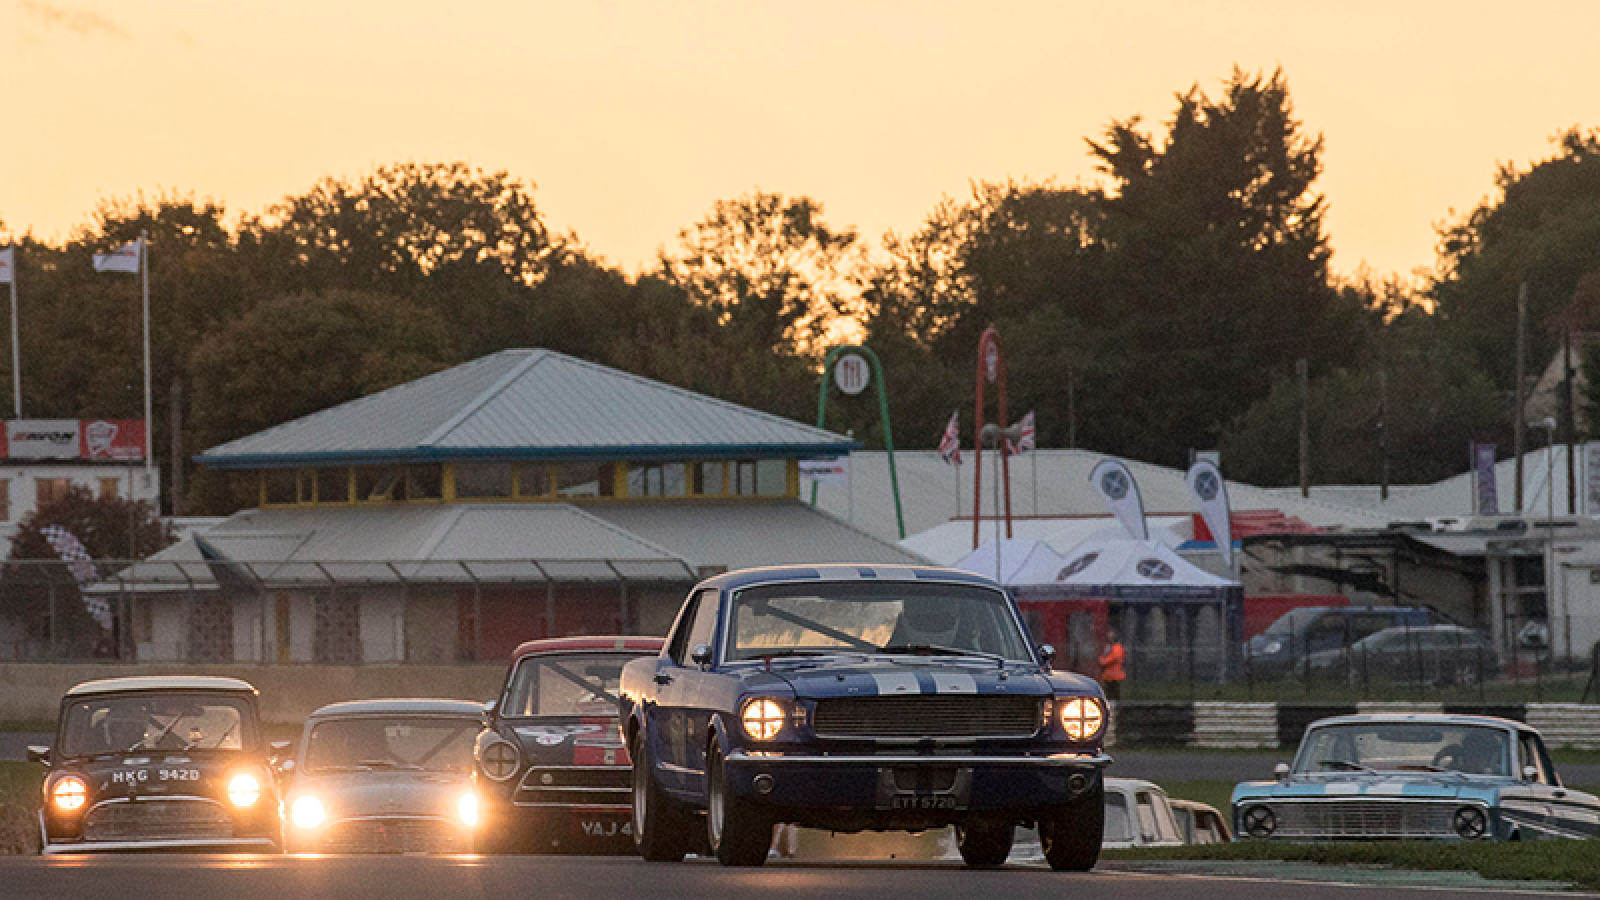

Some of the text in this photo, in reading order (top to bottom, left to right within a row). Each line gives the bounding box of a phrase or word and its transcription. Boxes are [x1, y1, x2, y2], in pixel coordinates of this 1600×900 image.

[113, 769, 199, 782] HKG 942D
[581, 821, 617, 836] YAJ
